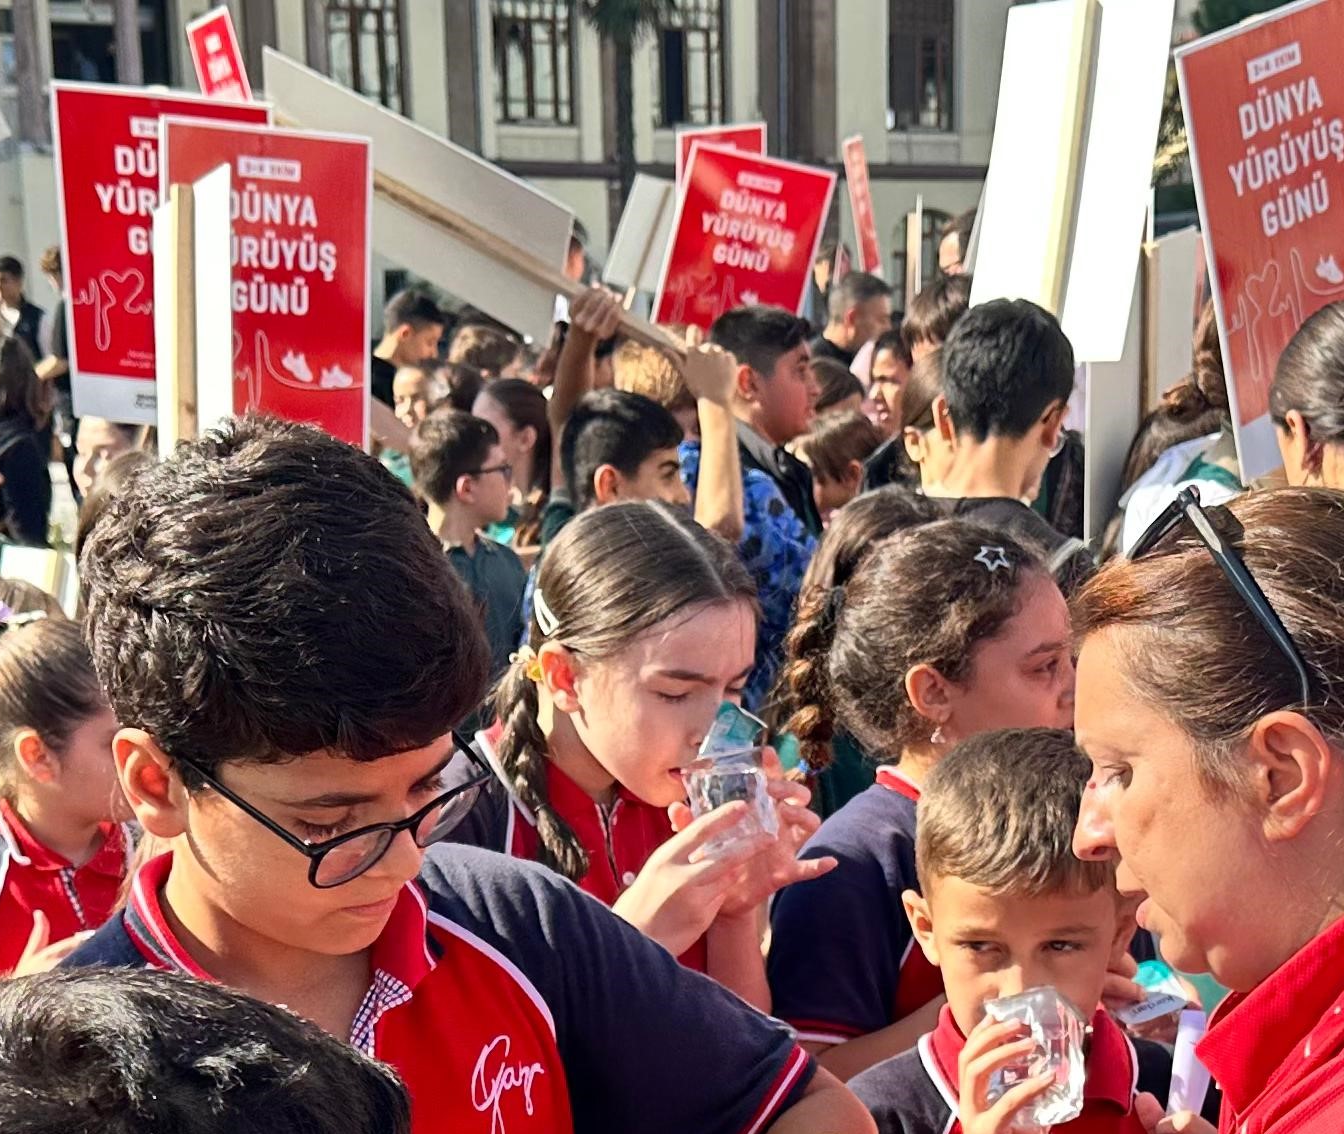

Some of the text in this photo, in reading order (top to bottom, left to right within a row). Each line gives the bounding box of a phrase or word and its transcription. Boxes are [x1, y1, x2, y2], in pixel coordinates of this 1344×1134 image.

[1238, 76, 1323, 140] DÜNYA
[720, 188, 787, 224] DÜNYA
[1261, 170, 1330, 237] GÜNÜ
[712, 241, 771, 273] GÜNÜ
[231, 273, 309, 316] GÜNÜ
